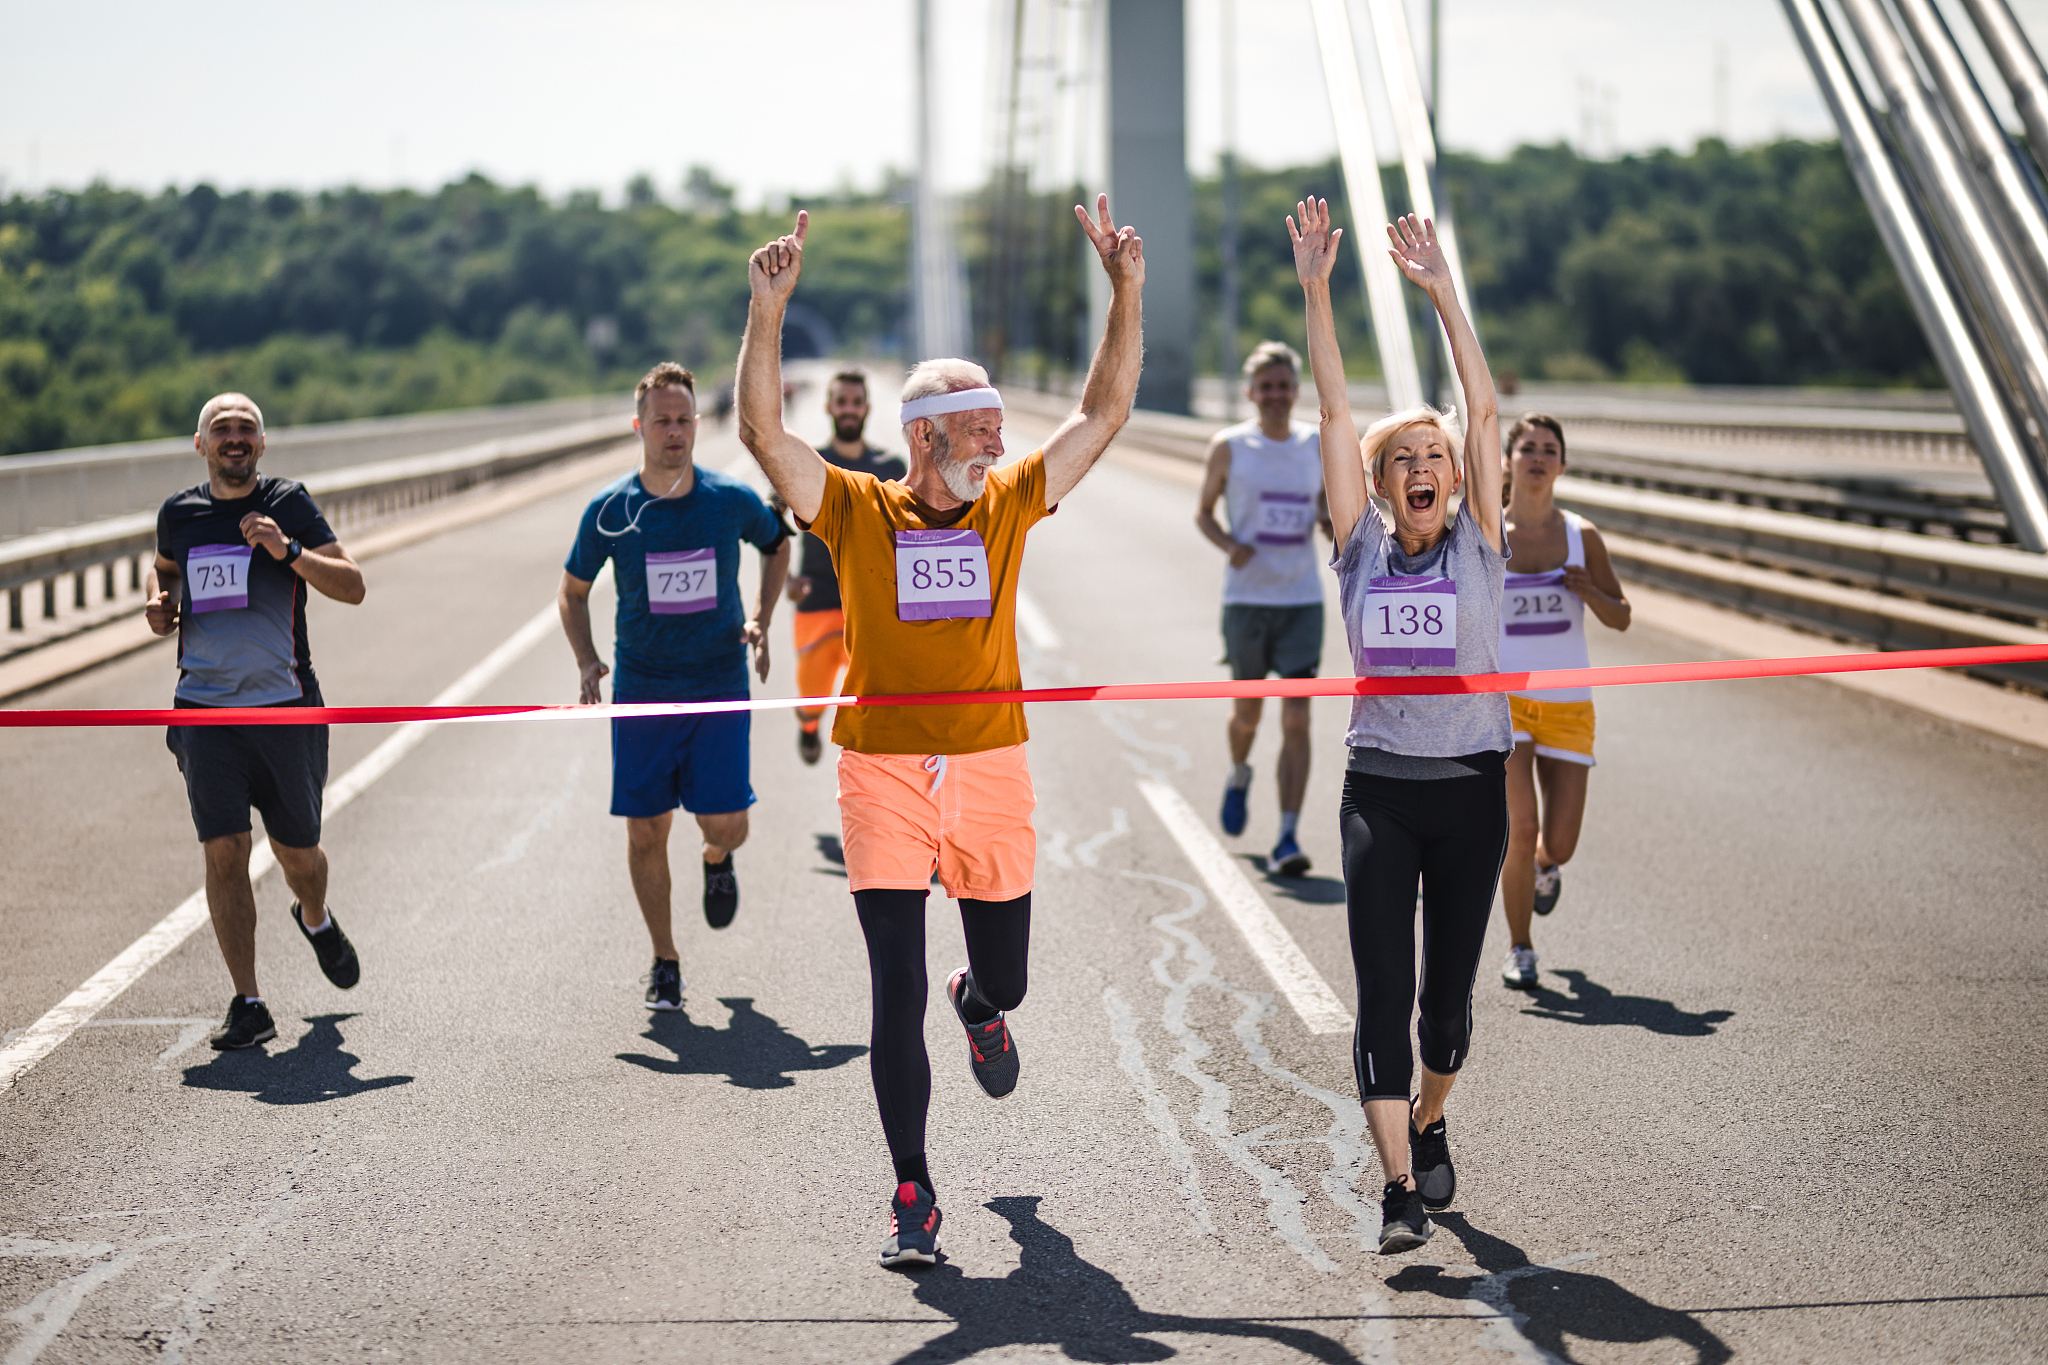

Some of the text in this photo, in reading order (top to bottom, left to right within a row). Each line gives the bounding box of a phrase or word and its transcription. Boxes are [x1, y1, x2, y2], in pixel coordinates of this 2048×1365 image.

[197, 563, 238, 591] 731
[658, 569, 708, 594] 737
[912, 558, 976, 590] 855
[1513, 594, 1563, 616] 212
[1378, 604, 1443, 636] 138
